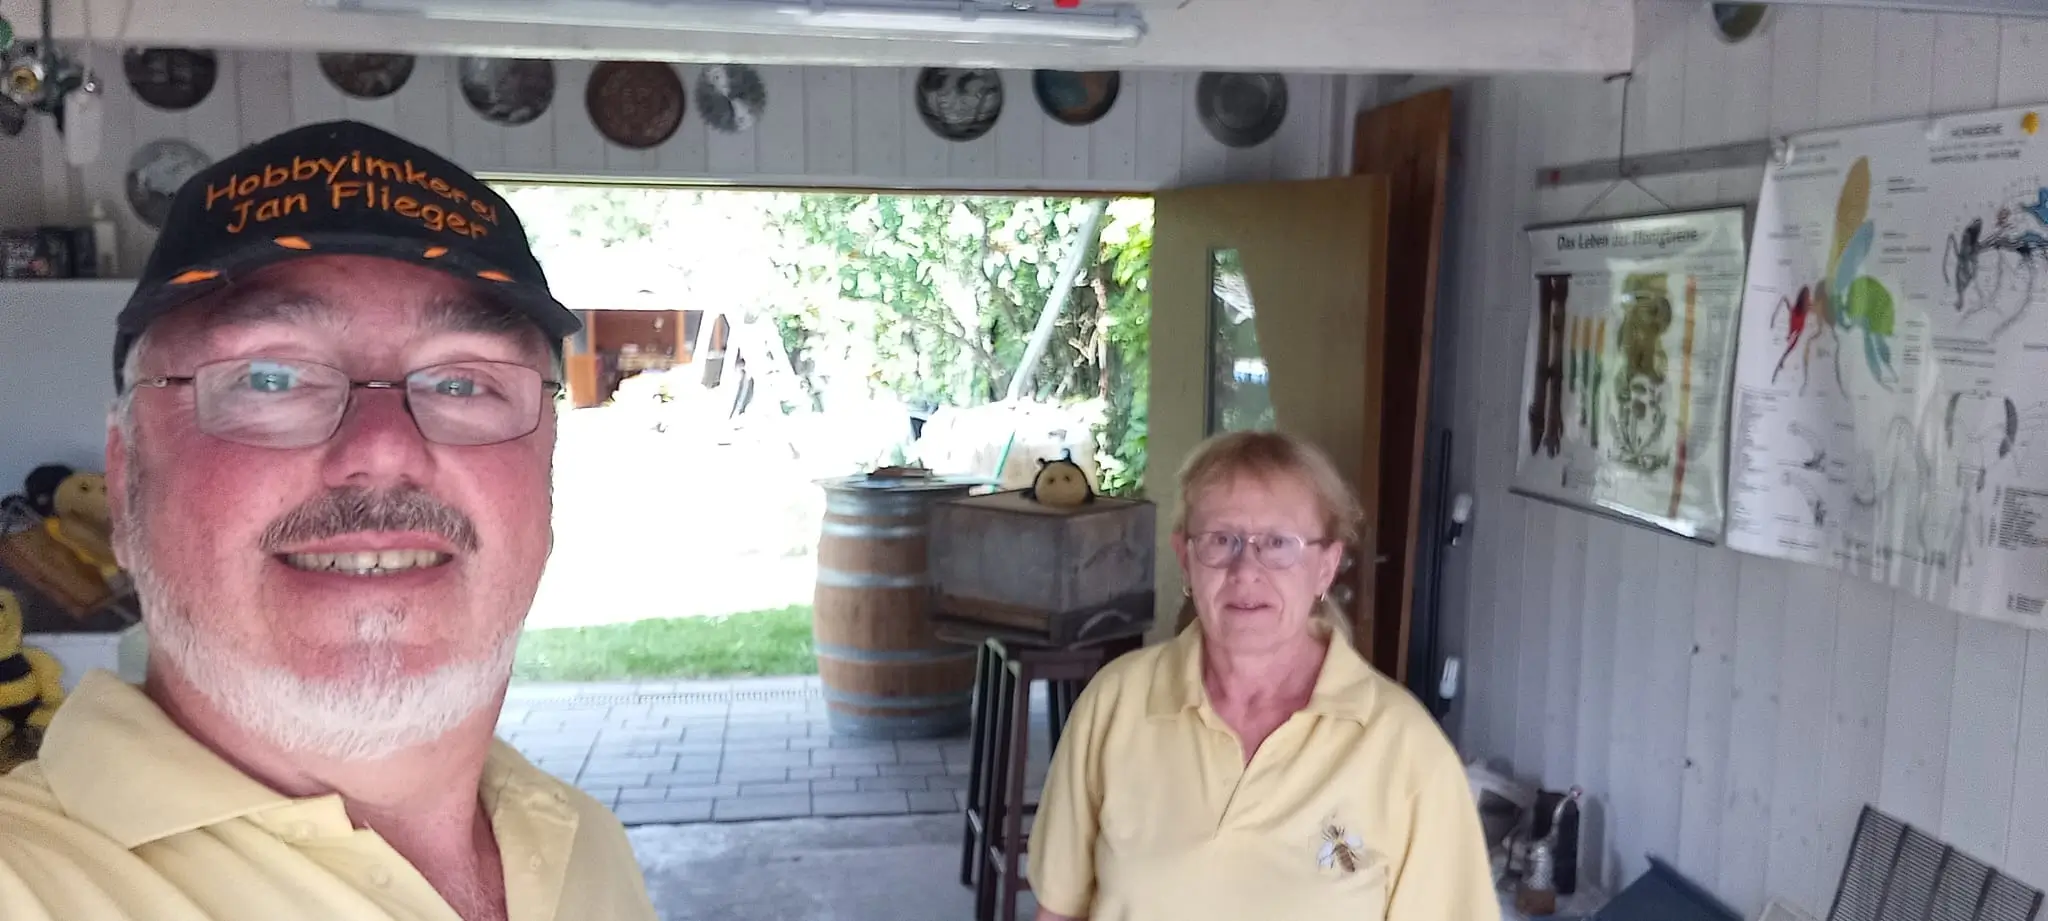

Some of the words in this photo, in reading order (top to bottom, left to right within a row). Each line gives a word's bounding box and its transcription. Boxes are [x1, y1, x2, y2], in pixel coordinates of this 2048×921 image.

[226, 193, 309, 235] Jan
[330, 180, 489, 241] Flieger
[1557, 234, 1576, 251] Das
[1578, 232, 1609, 249] Leben
